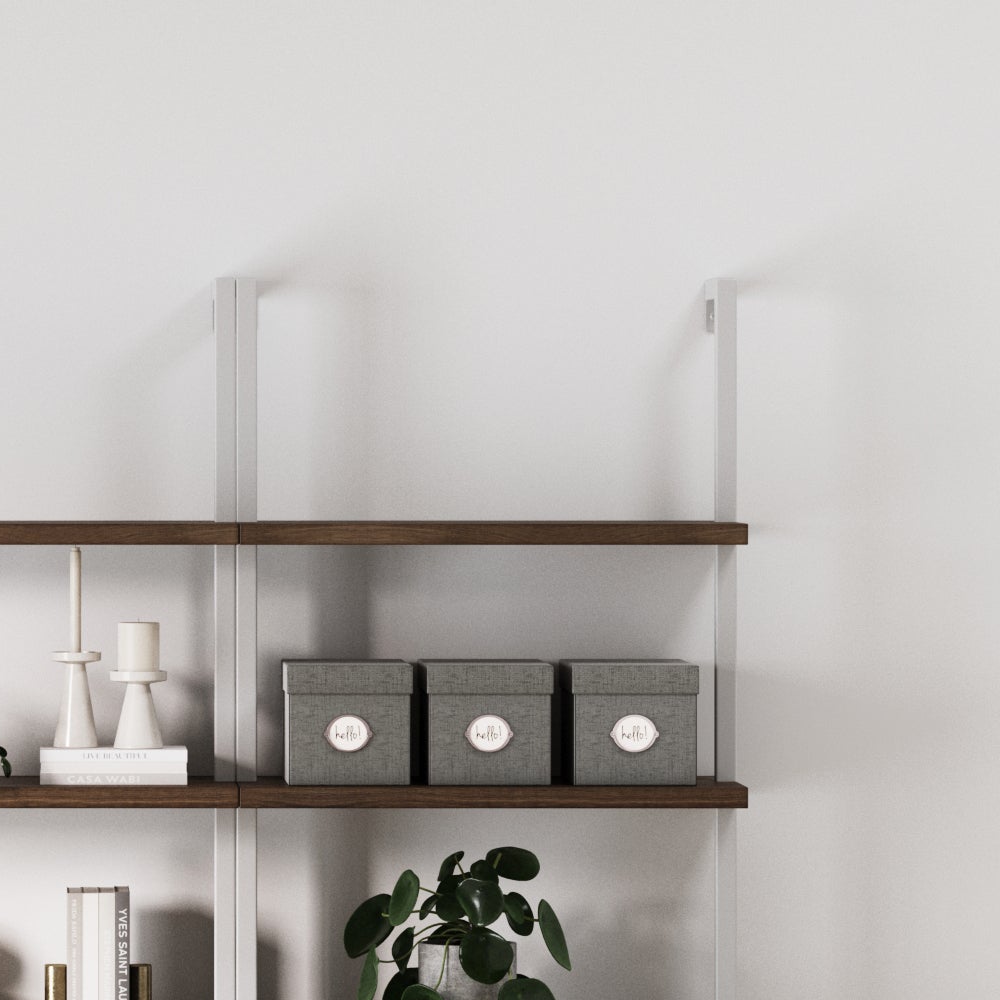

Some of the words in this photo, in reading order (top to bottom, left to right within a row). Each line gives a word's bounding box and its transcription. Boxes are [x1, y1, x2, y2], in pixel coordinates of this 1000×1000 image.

[334, 725, 361, 742] hello!
[475, 725, 502, 742] hello!
[621, 725, 648, 742] hello!
[67, 775, 104, 784] CASA
[106, 775, 141, 784] WABI
[118, 909, 128, 938] YVES
[118, 941, 128, 975] SAINT
